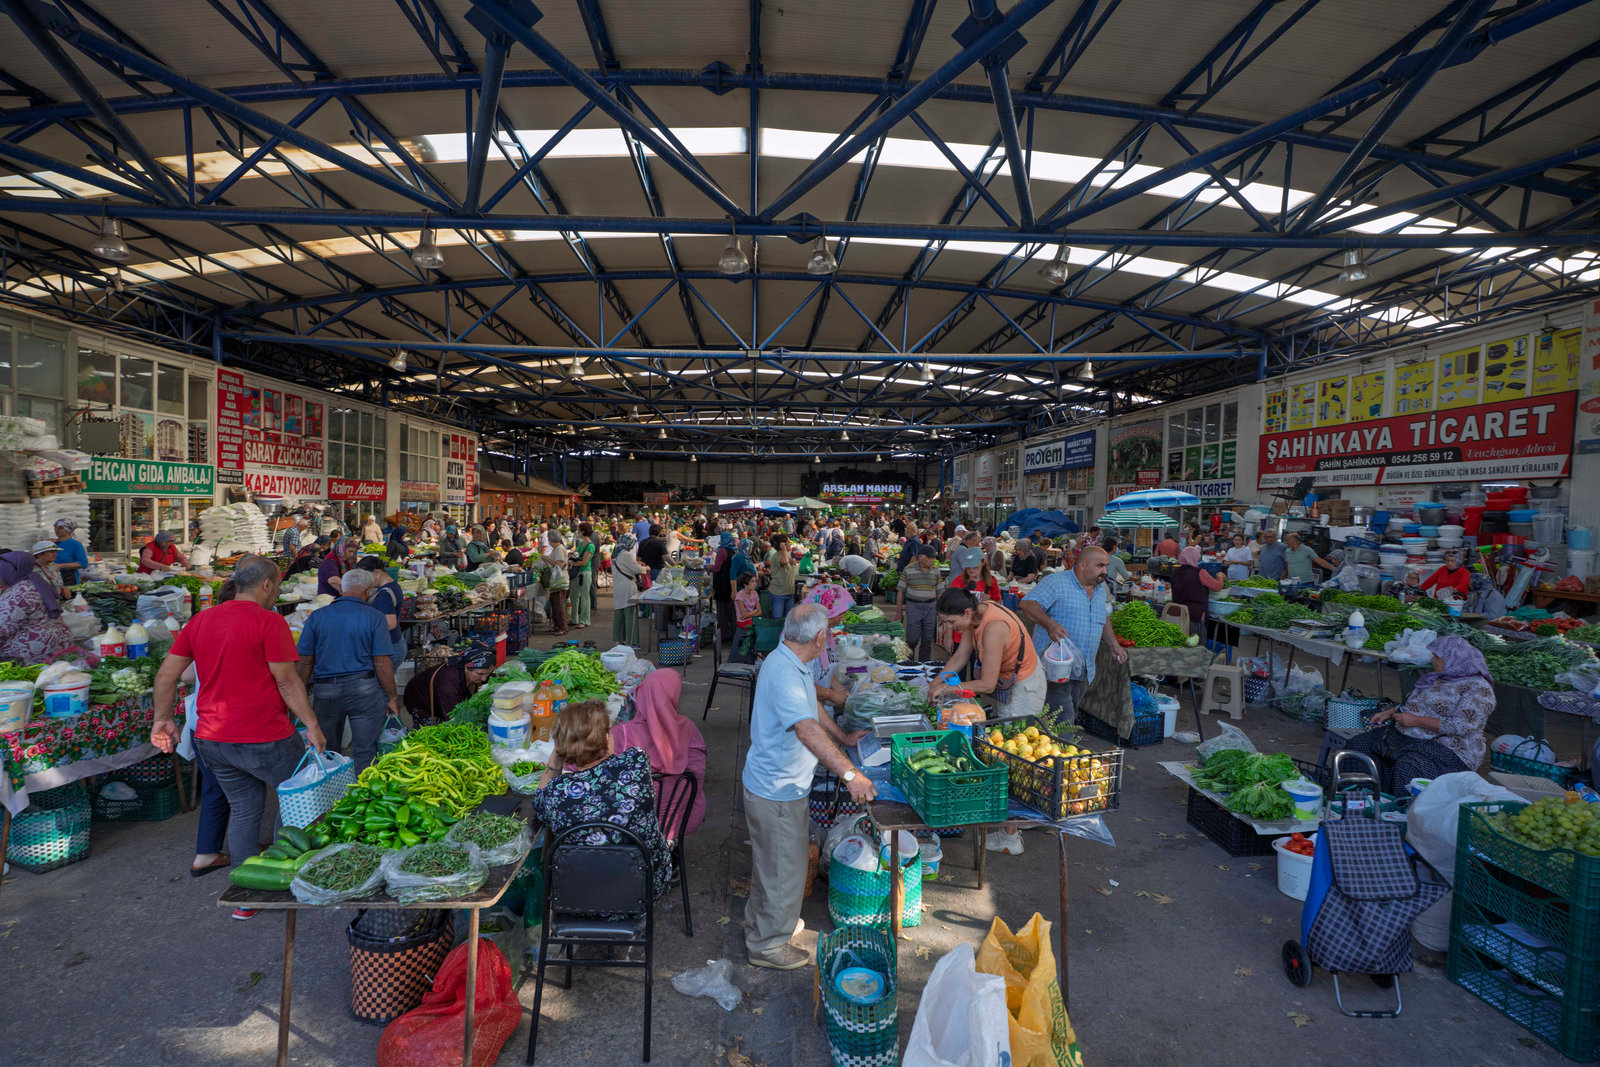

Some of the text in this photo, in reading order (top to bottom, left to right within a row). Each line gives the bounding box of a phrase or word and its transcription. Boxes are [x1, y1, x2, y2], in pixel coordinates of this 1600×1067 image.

[1266, 426, 1393, 464] ŞAHİNKAYA
[1409, 404, 1556, 447] TİCARET
[245, 442, 322, 467] SARAY ZÜCCACİYE
[1320, 451, 1453, 470] ŞAHİN ŞAHİNKAYA 0544 256 59 12
[88, 460, 211, 485] TEKCAN GIDA AMBALAJ
[447, 461, 463, 475] AYTEN
[1386, 470, 1403, 479] DÜĞÜN
[1411, 469, 1423, 478] ÖZEL
[1424, 467, 1455, 477] GÜNLERİNİZ
[1456, 466, 1468, 478] İÇİN
[1470, 467, 1486, 475] MASA
[1488, 465, 1520, 474] SANDALYE
[1521, 462, 1558, 472] KİRALANIR
[245, 473, 320, 495] KAPATIYORUZ
[355, 482, 384, 495] Market
[448, 477, 465, 490] EMLAK
[1194, 481, 1232, 496] TİCARET
